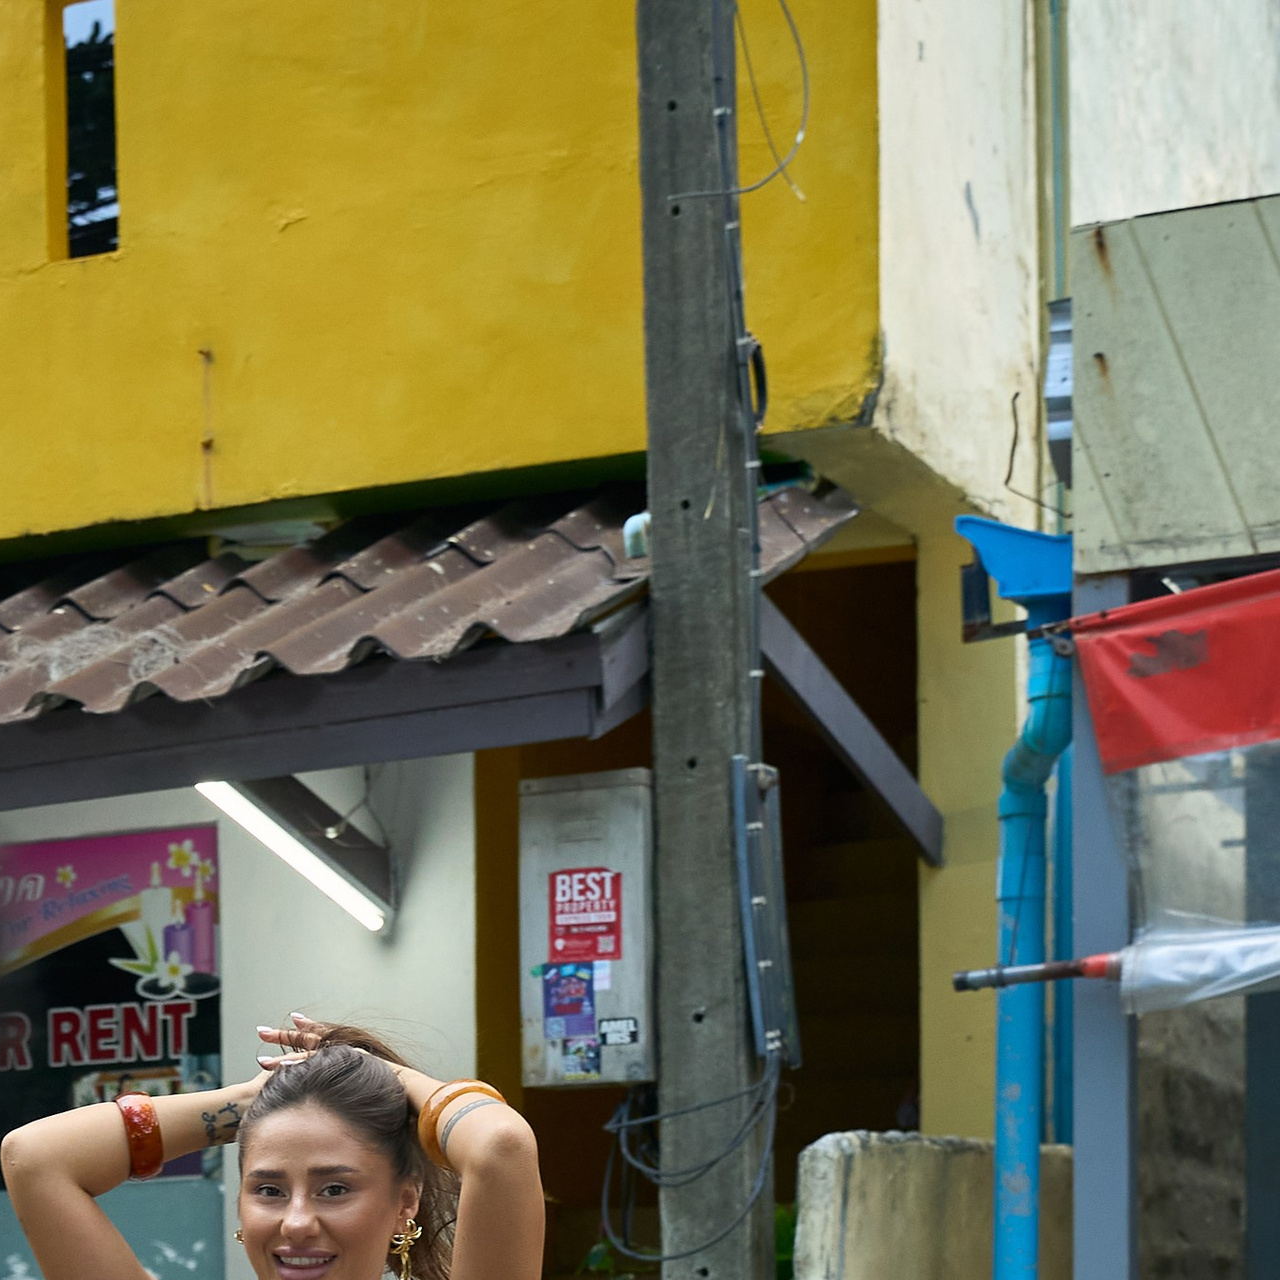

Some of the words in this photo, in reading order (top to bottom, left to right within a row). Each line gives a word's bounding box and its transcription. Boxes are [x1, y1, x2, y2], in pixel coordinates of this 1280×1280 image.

[556, 871, 615, 902] BEST
[556, 900, 616, 914] PROPERTY
[47, 1000, 197, 1068] RENT
